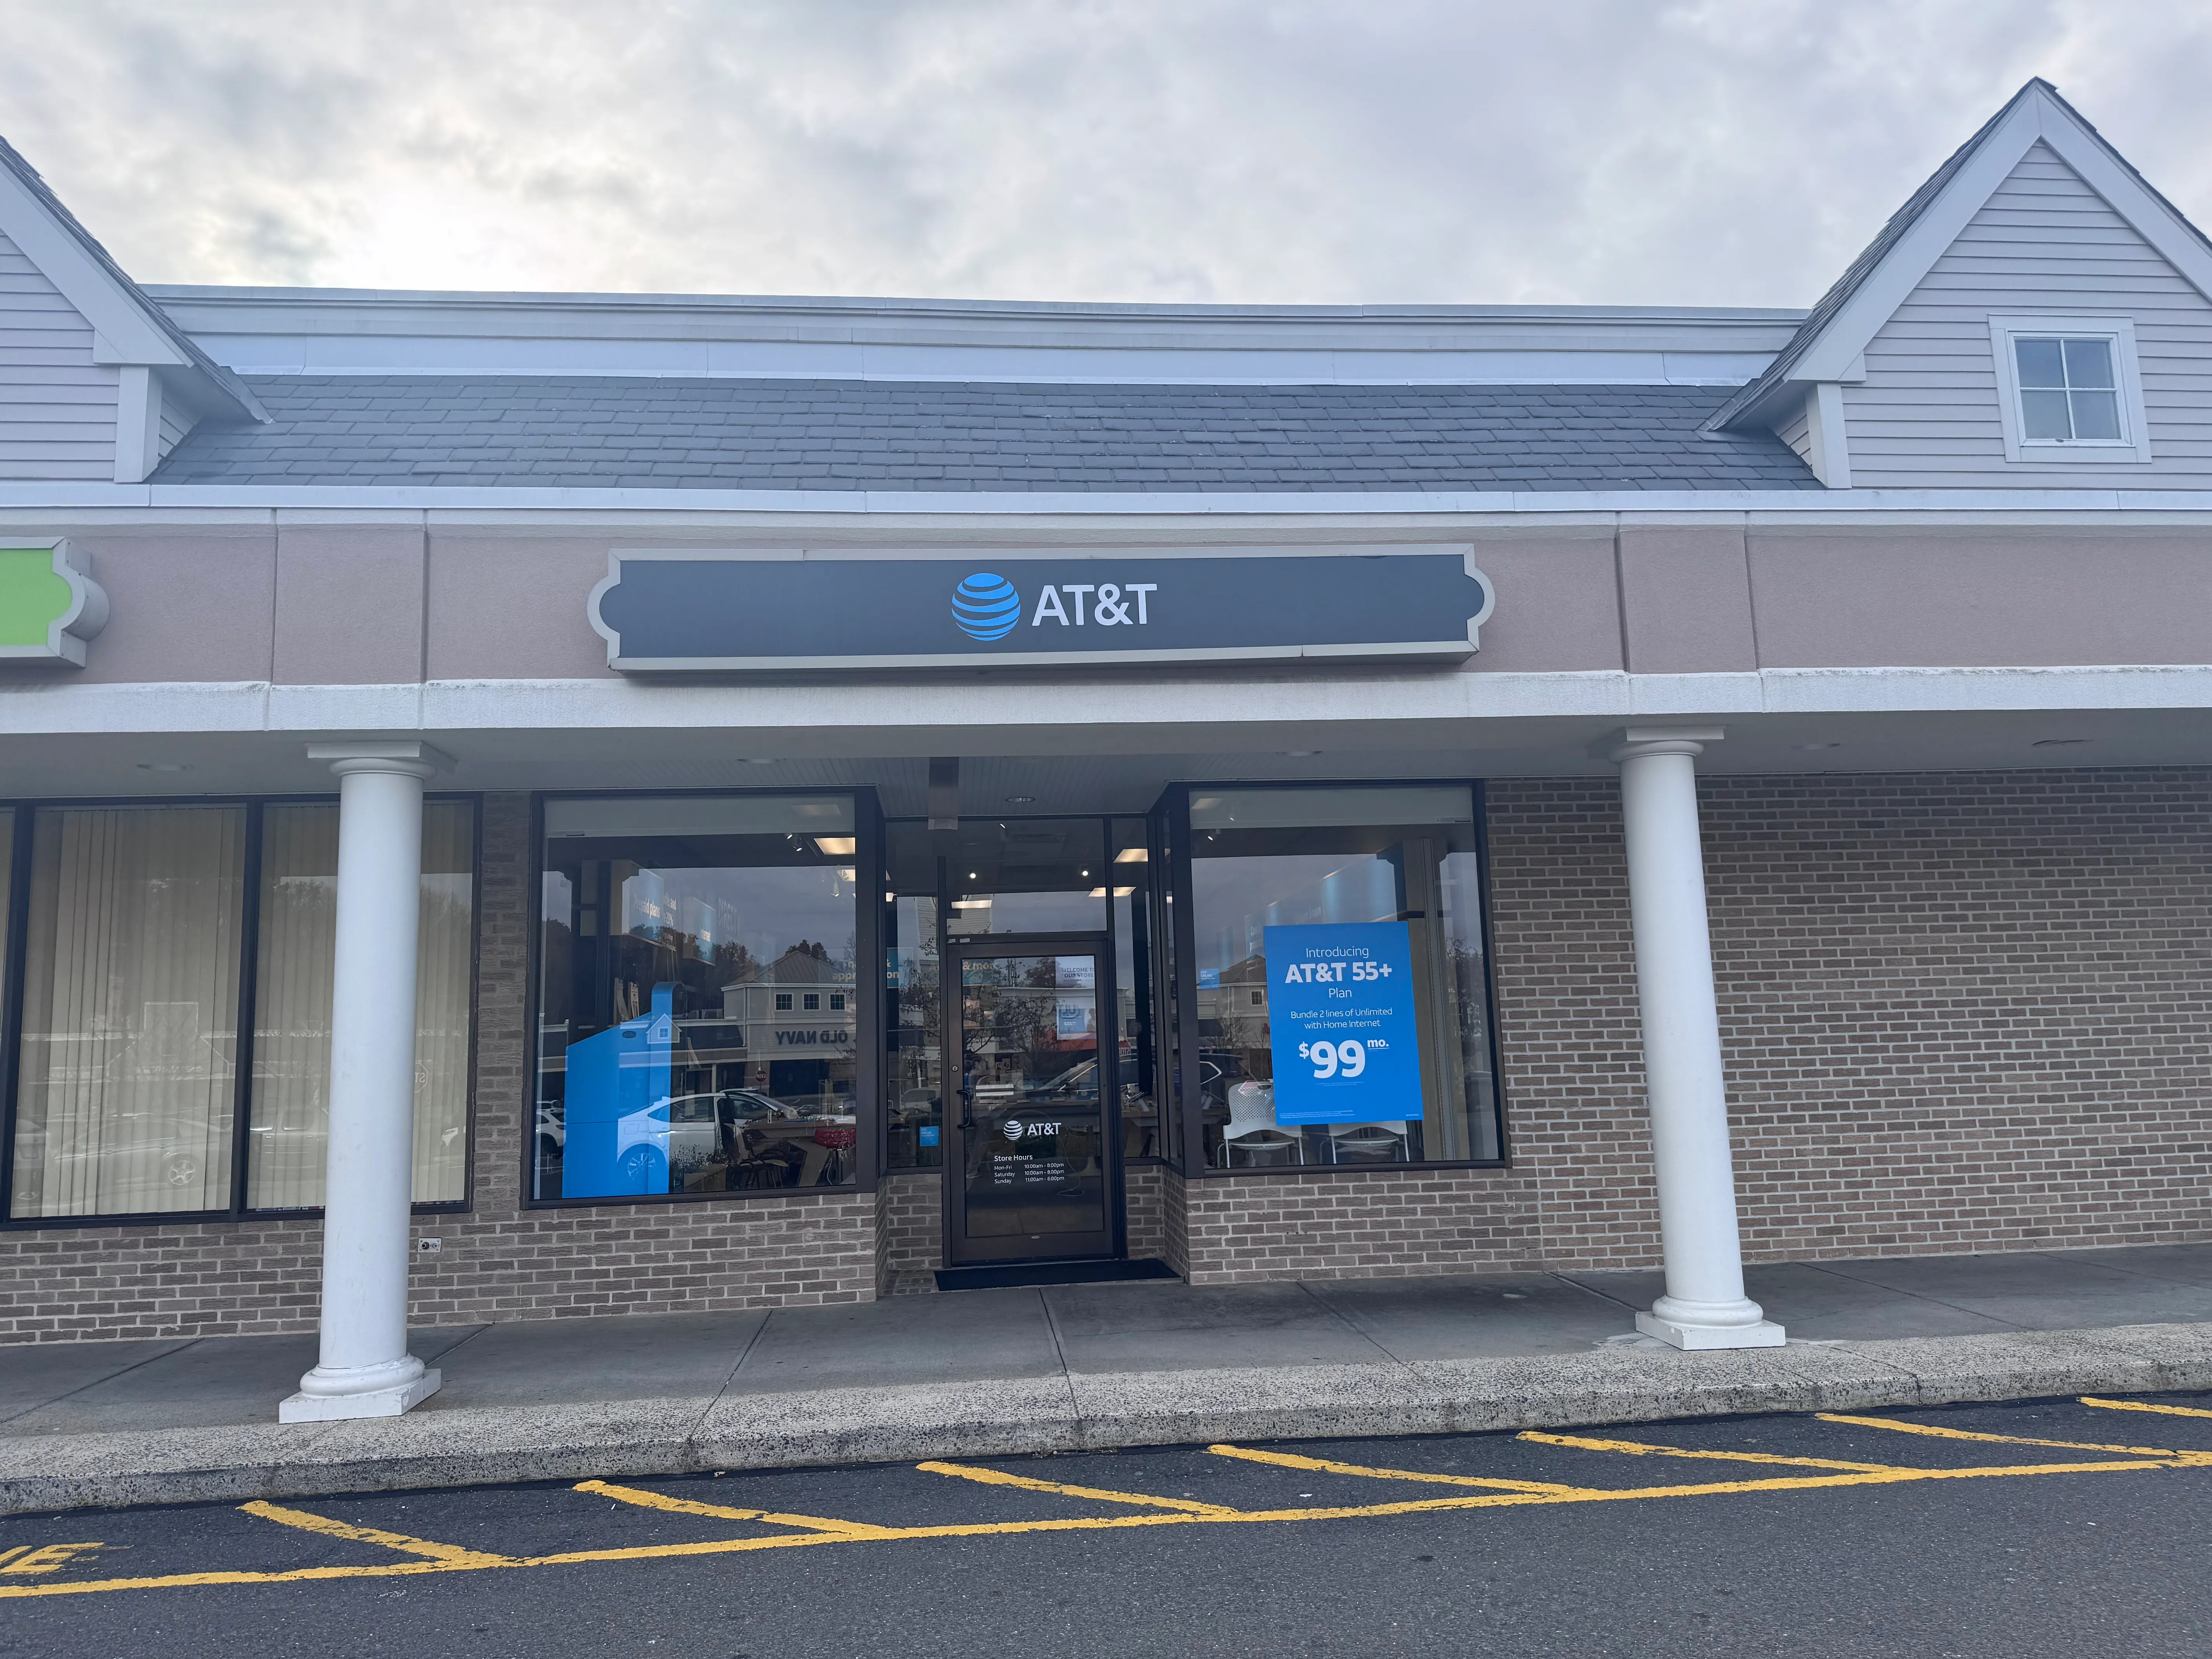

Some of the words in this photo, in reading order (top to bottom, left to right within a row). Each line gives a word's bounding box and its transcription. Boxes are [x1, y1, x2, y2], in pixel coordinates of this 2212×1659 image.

[1032, 584, 1157, 626] AT&T
[1306, 946, 1369, 958] Introducing
[1285, 962, 1346, 983] AT&T
[1353, 962, 1392, 981] 55+
[1329, 988, 1352, 998] Plan
[1291, 1010, 1318, 1018] Bundle
[1326, 1009, 1343, 1017] lines
[1355, 1008, 1392, 1016] Unlimited
[1324, 1020, 1347, 1029] Home
[1349, 1019, 1380, 1027] Internet
[1299, 1040, 1365, 1079] $99
[1367, 1039, 1389, 1048] mo.
[1027, 1123, 1061, 1136] AT&T
